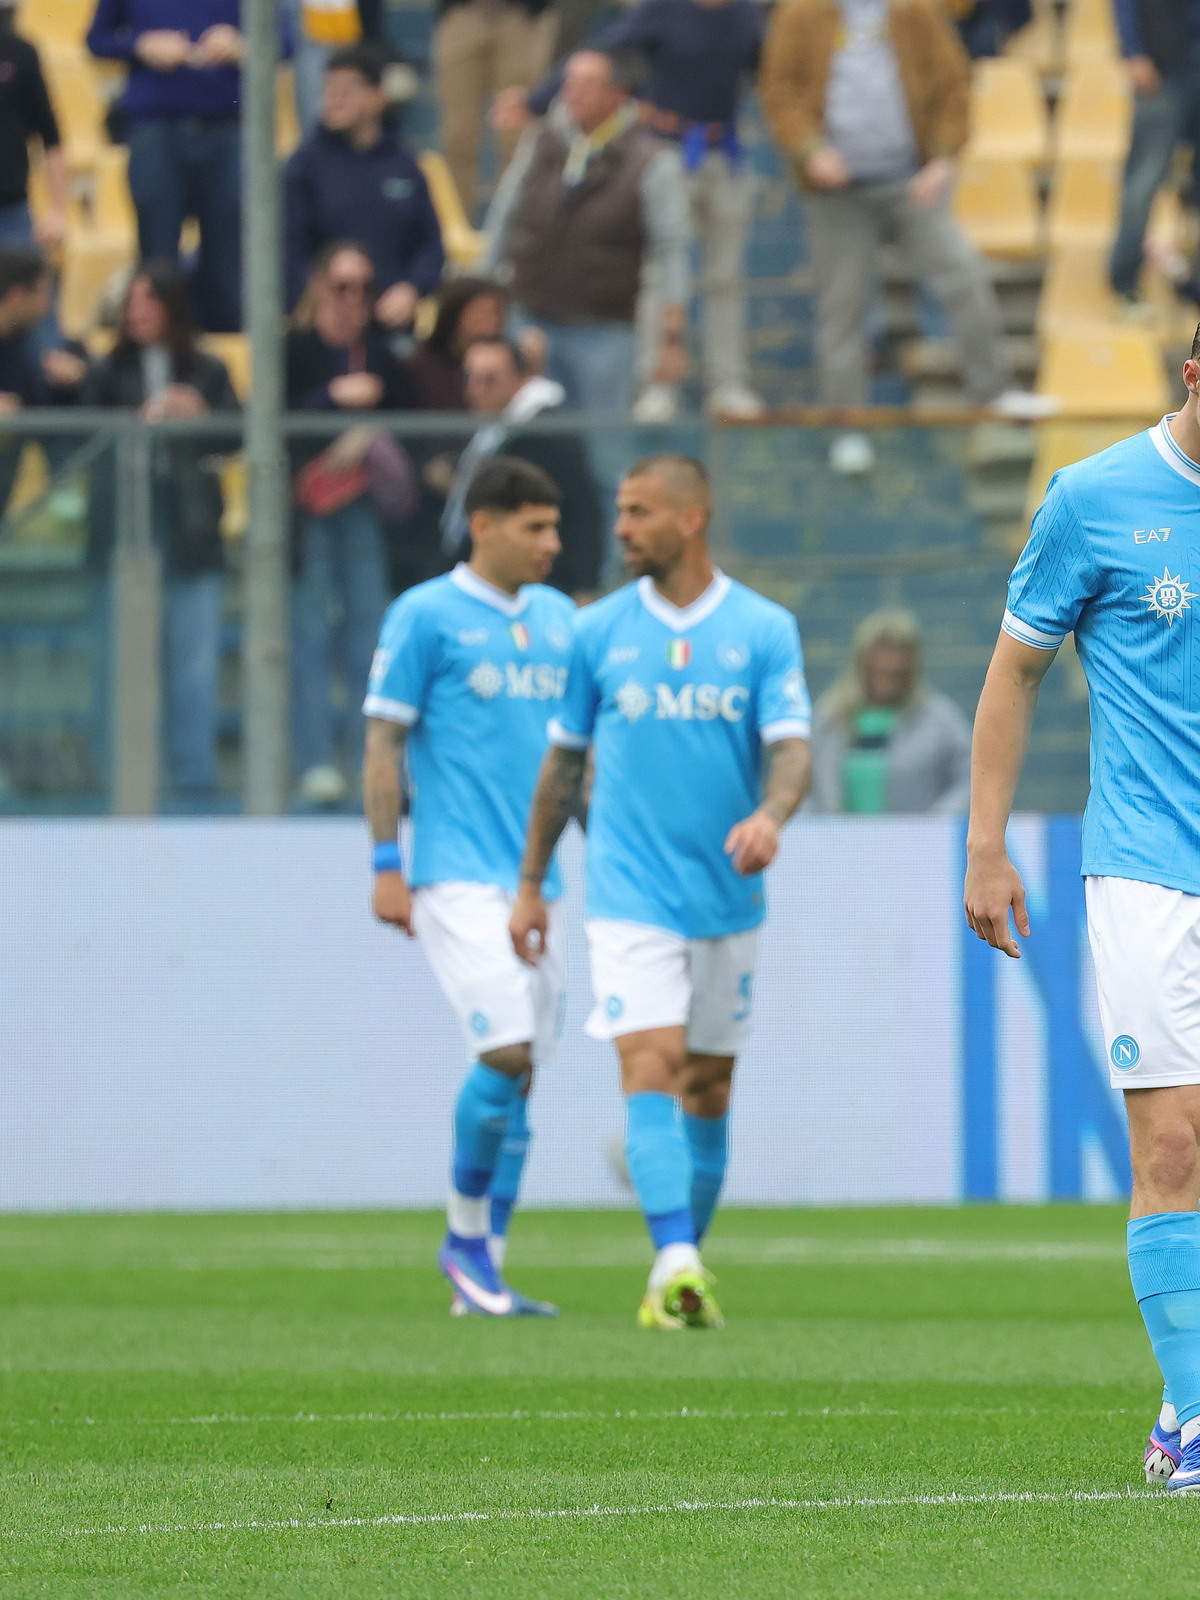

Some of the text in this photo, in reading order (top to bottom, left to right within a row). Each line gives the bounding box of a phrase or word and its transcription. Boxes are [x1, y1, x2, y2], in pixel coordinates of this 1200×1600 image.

[1133, 527, 1172, 545] EA7
[655, 682, 750, 722] MSC
[1118, 1043, 1133, 1061] N
